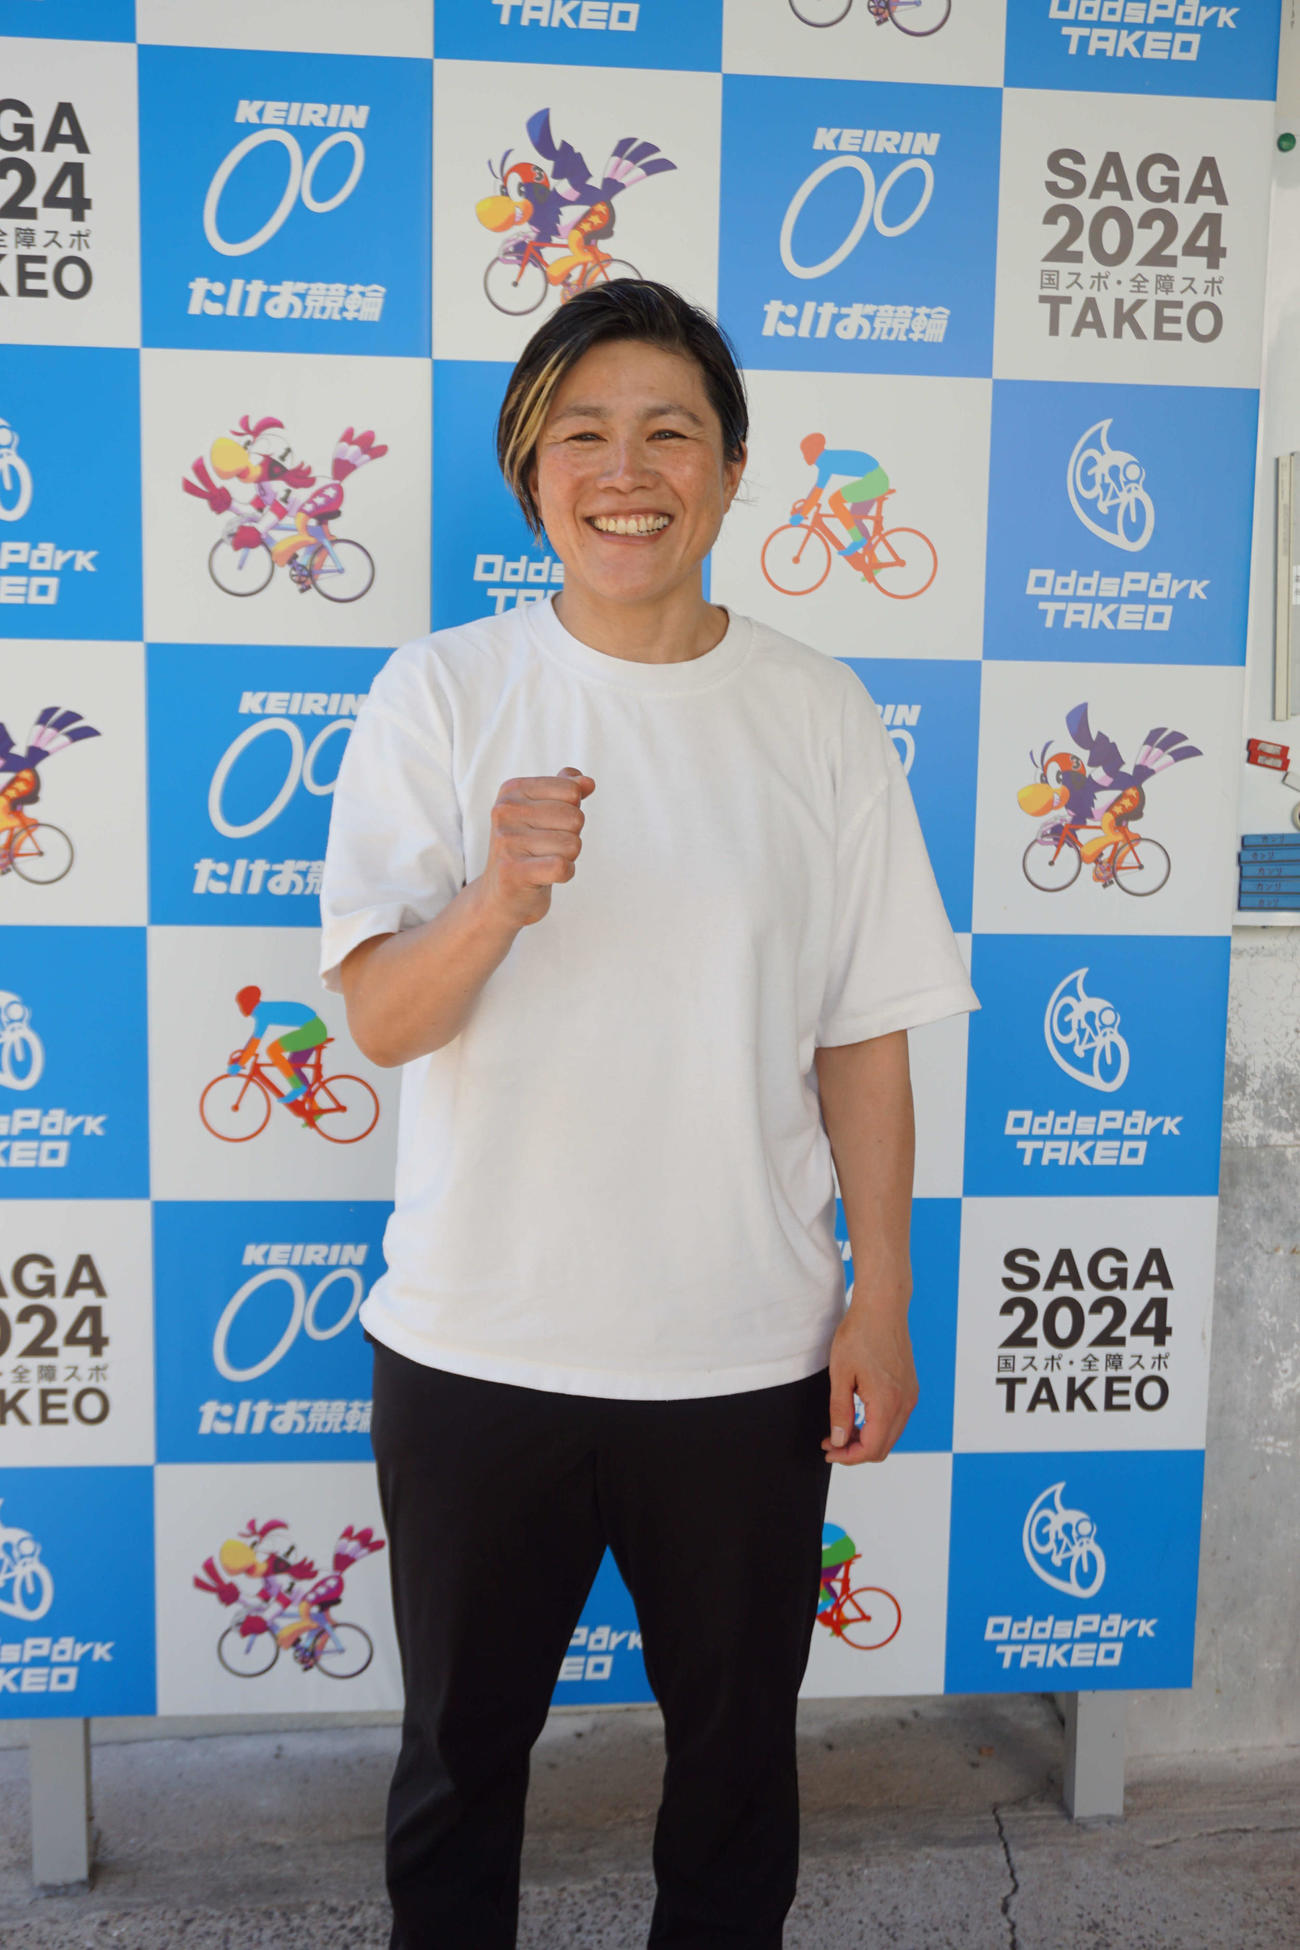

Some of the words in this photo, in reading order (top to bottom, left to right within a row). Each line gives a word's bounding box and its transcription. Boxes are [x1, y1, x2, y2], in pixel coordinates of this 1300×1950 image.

[492, 0, 640, 31] TAKEO
[1049, 0, 1239, 31] OddsPark
[1061, 27, 1200, 60] TAKEO
[235, 100, 369, 128] KEIRIN
[813, 128, 940, 155] KEIRIN
[1045, 149, 1228, 205] SAGA
[1041, 202, 1228, 269] 2024
[0, 254, 92, 300] EO
[1039, 268, 1225, 298] 国スポ・全障スポ
[188, 278, 386, 321] たけお競輪
[762, 300, 950, 342] たけお競輪
[1039, 295, 1223, 343] TAKEO
[1026, 569, 1209, 599] OddsPark
[1038, 602, 1173, 630] TAKEO
[875, 704, 922, 726] IN
[1005, 1110, 1182, 1135] OddsPark
[1017, 1141, 1147, 1165] TAKEO
[243, 1244, 367, 1265] KEIRIN
[1002, 1248, 1173, 1292] SAGA
[0, 1254, 106, 1299] GA
[0, 1304, 109, 1357] 24
[999, 1296, 1172, 1349] 2024
[996, 1353, 1170, 1373] 国スポ・全障スポ
[996, 1375, 1169, 1412] TAKEO
[984, 1614, 1157, 1640] OddsPark
[996, 1642, 1123, 1668] TAKEO
